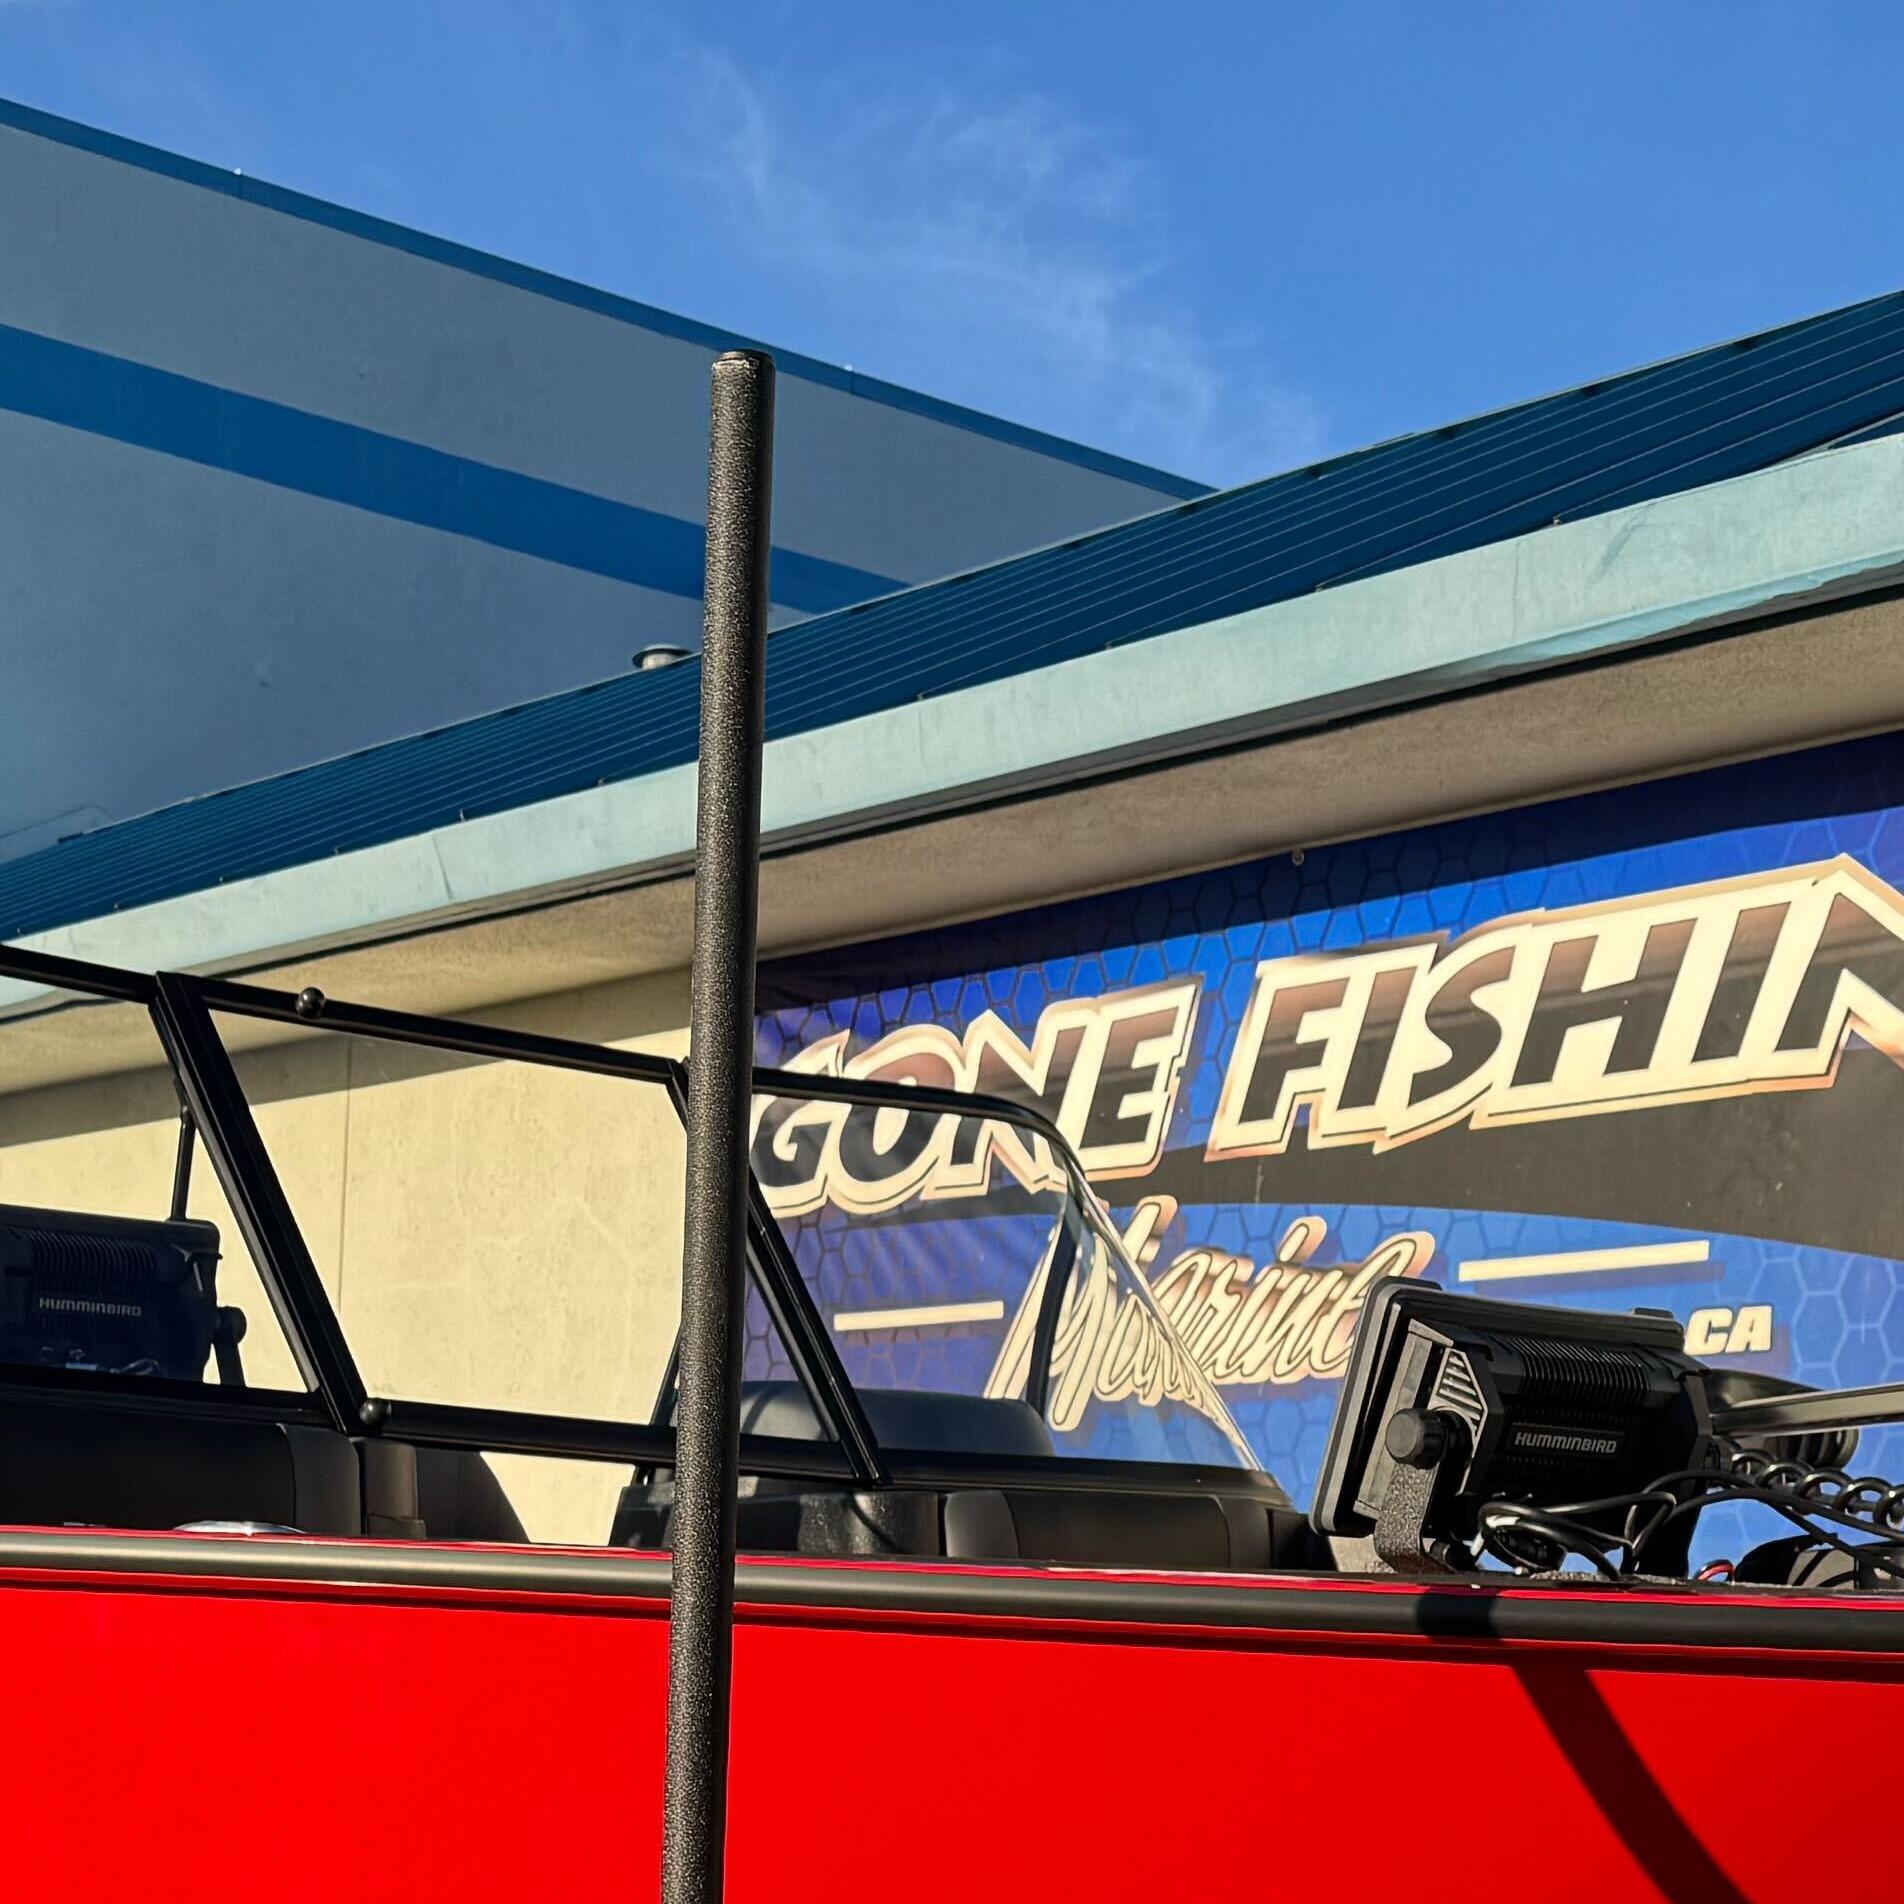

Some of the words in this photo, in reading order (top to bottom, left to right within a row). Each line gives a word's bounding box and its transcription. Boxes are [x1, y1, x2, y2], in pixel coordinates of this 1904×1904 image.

[752, 979, 1203, 1219] GONE
[39, 1297, 142, 1317] HUMMINBIRD
[1683, 1305, 1773, 1357] CA
[1514, 1431, 1617, 1454] HUMMINBIRD
